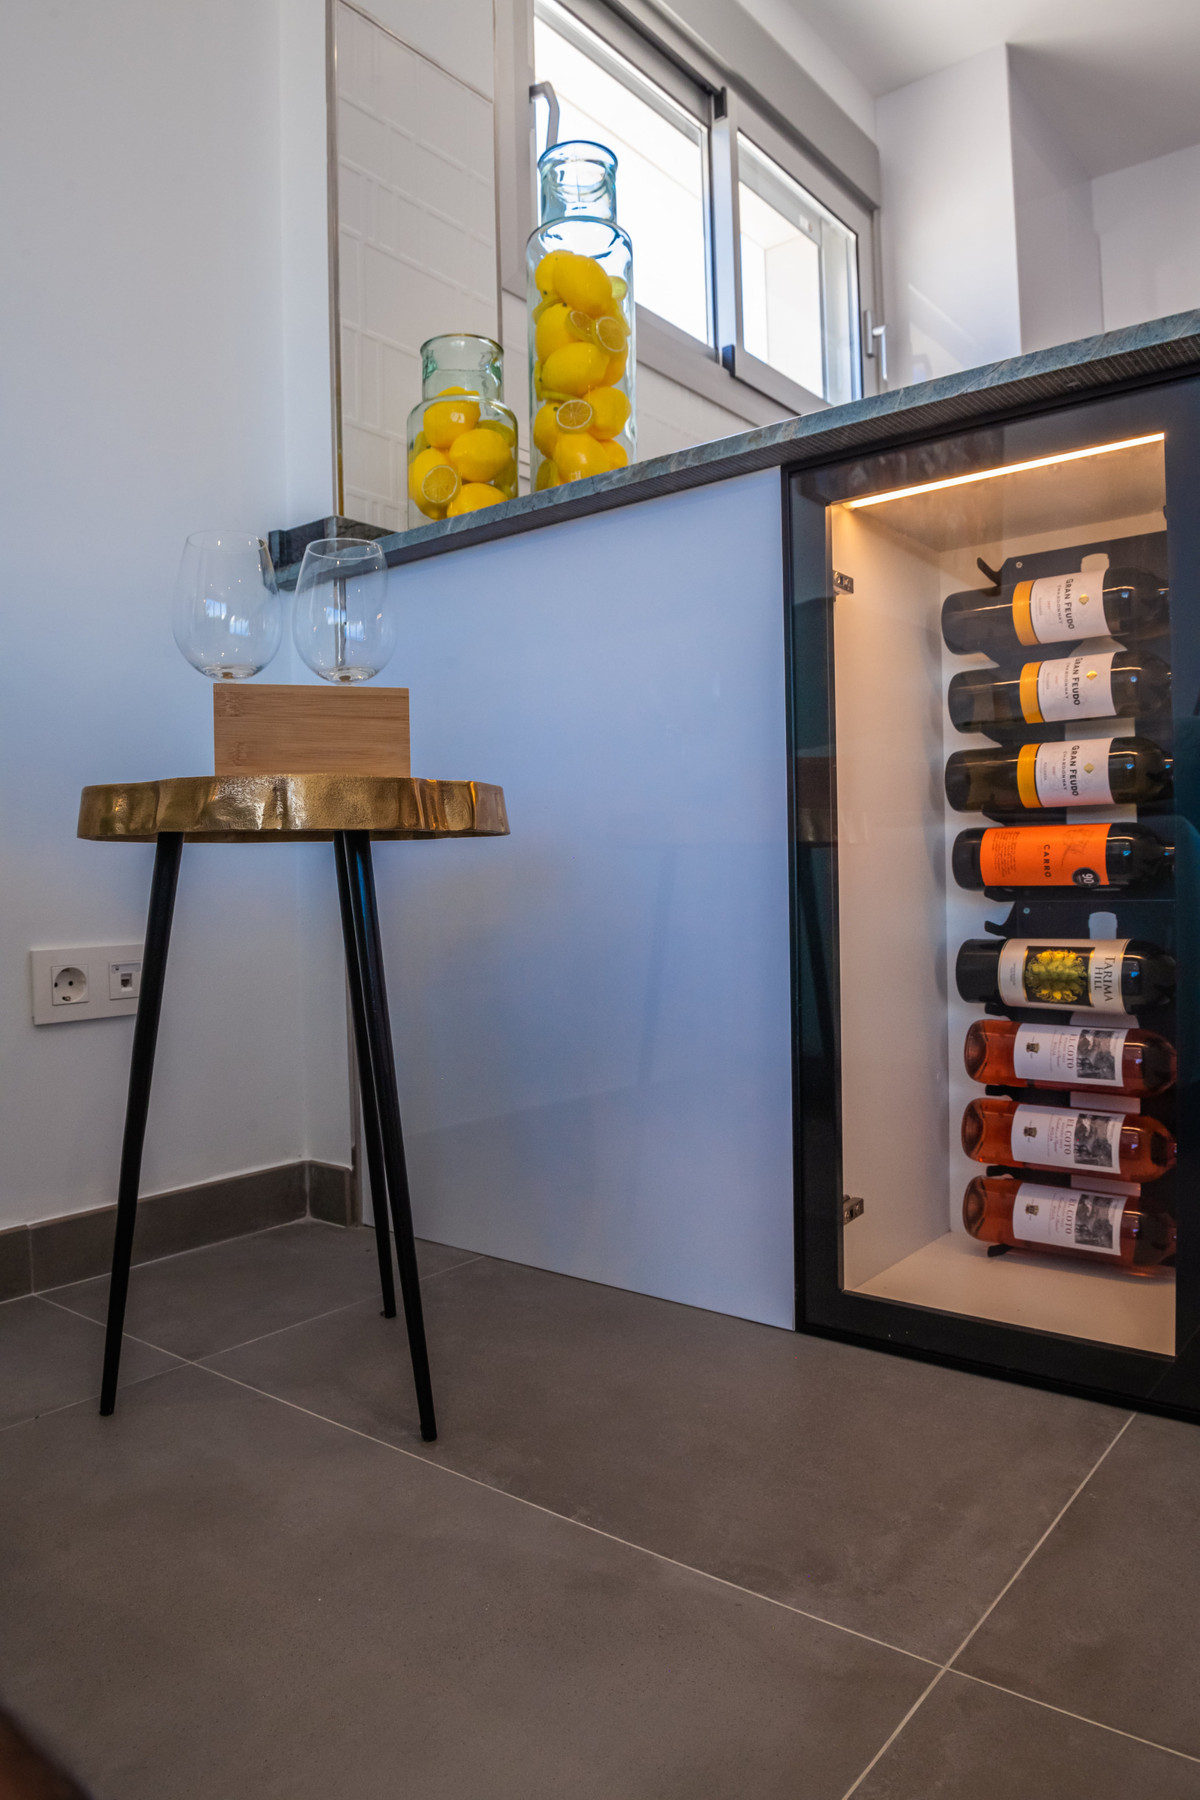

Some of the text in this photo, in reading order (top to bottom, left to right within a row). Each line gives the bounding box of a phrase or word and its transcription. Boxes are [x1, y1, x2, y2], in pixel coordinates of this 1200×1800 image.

[1064, 578, 1075, 629] GRAN FEUDO
[1071, 657, 1083, 706] GRAN FEUDO
[1069, 745, 1080, 796] GRAN FEUDO
[1043, 844, 1052, 878] CARRO
[1082, 873, 1094, 884] 90
[1093, 967, 1104, 991] HILL
[1103, 956, 1116, 1002] TARIMA
[1067, 1044, 1075, 1069] COTO
[1064, 1118, 1074, 1155] EL COTO
[1064, 1198, 1076, 1235] EL COTO
